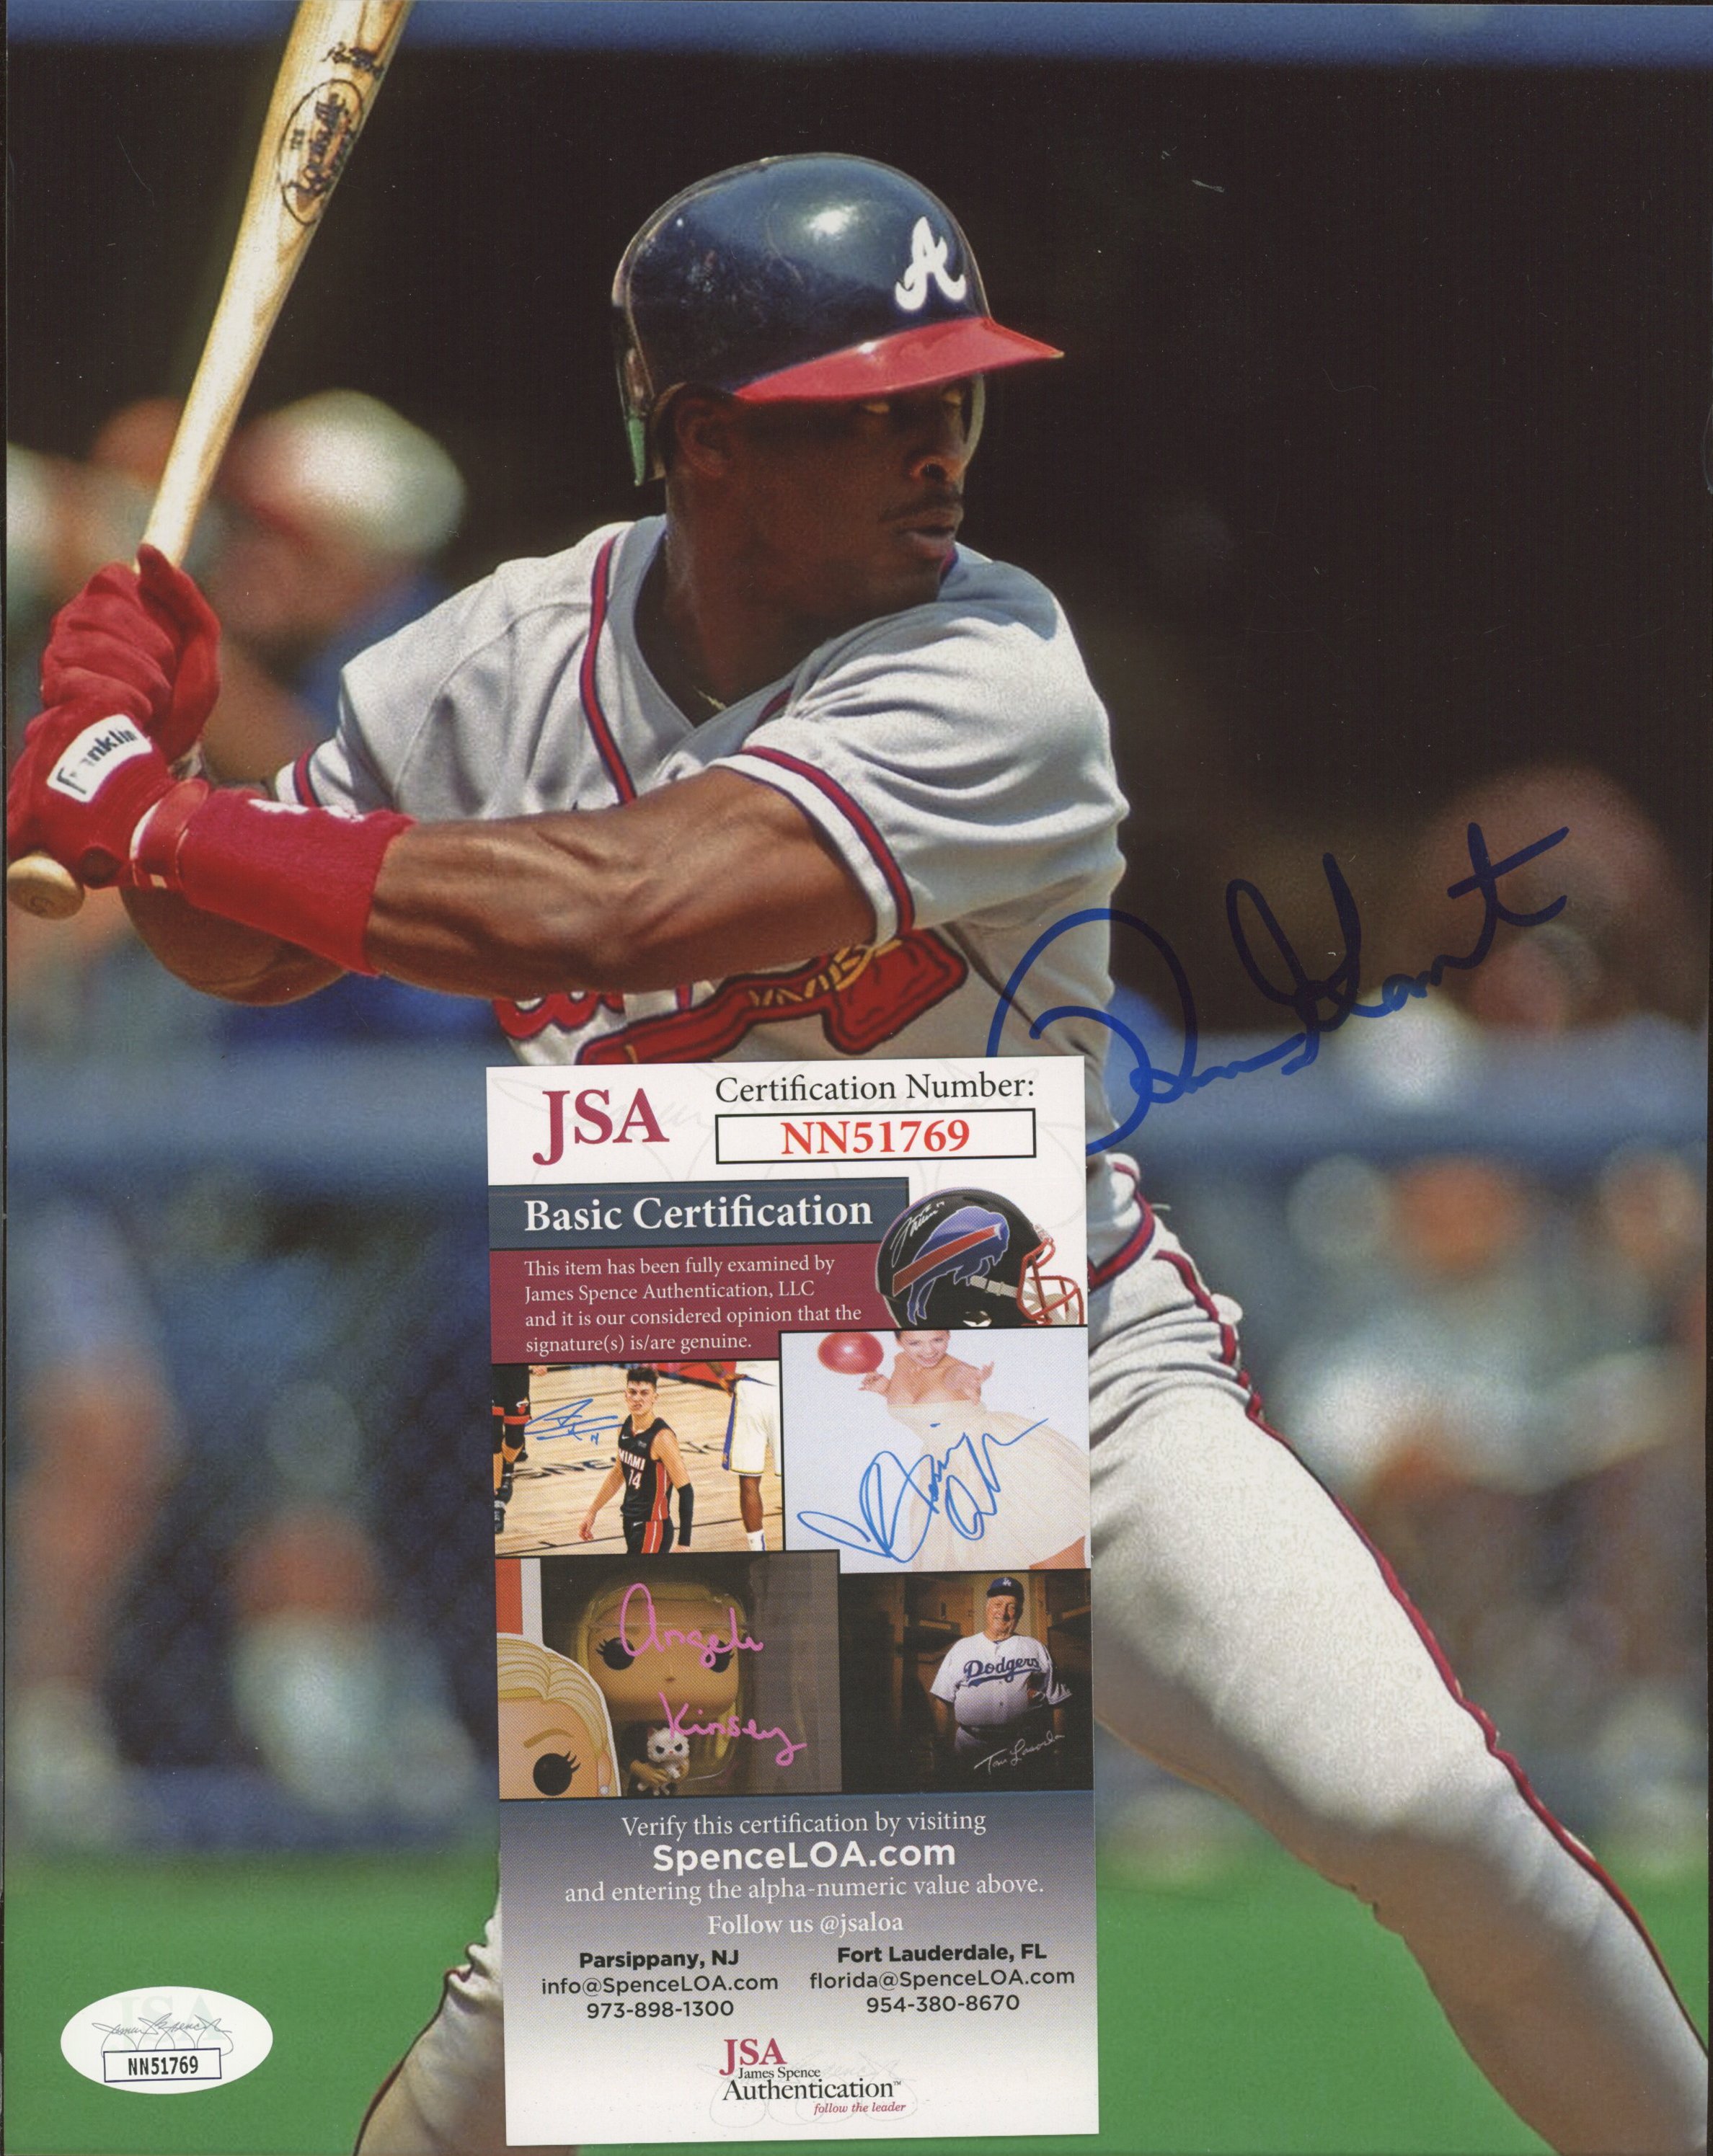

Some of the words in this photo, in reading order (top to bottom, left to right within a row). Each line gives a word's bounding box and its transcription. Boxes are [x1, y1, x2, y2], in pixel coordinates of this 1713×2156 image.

[895, 216, 966, 311] A
[56, 728, 138, 795] Fnklin
[715, 1074, 897, 1103] Certification
[905, 1070, 1034, 1099] Number:
[533, 1088, 669, 1166] JSA
[782, 1119, 970, 1155] NN51769
[524, 1199, 622, 1231] Basic
[632, 1194, 873, 1229] Certification
[524, 1260, 560, 1276] This
[566, 1259, 601, 1275] item
[607, 1259, 635, 1274] has
[640, 1258, 680, 1274] been
[686, 1256, 723, 1277] fully
[727, 1254, 810, 1272] examined
[814, 1254, 835, 1275] by
[525, 1286, 574, 1304] James
[579, 1285, 637, 1305] Spence
[642, 1282, 774, 1299] Authentication,
[778, 1280, 815, 1296] LLC
[526, 1310, 557, 1326] and
[562, 1310, 573, 1326] it
[577, 1310, 591, 1326] is
[596, 1314, 626, 1326] our
[630, 1307, 722, 1325] considered
[727, 1308, 792, 1328] opinion
[797, 1305, 831, 1321] that
[835, 1304, 862, 1321] the
[526, 1334, 624, 1357] signature(s)
[630, 1334, 676, 1351] is/are
[681, 1334, 751, 1354] genuine.
[619, 1448, 646, 1470] MIAMI
[628, 1469, 642, 1490] 14
[963, 1656, 1041, 1683] Dodgers
[621, 1814, 688, 1842] Verify
[693, 1814, 733, 1835] this
[739, 1812, 869, 1835] certification
[875, 1811, 901, 1837] by
[906, 1811, 986, 1836] visiting
[653, 1840, 955, 1876] SpenceLOA.com
[565, 1881, 605, 1902] and
[611, 1881, 702, 1906] entering
[707, 1880, 742, 1899] the
[748, 1876, 907, 1904] alpha-numeric
[913, 1874, 970, 1895] value
[976, 1873, 1044, 1894] above.
[708, 1914, 783, 1935] Follow
[789, 1919, 814, 1933] us
[820, 1911, 904, 1938] @jsaloa
[580, 1951, 705, 1971] Parsippany,
[712, 1949, 739, 1966] NJ
[838, 1947, 882, 1964] Fort
[889, 1943, 1014, 1963] Lauderdale,
[1021, 1943, 1048, 1960] FL
[541, 1975, 778, 1997] info@SpenceLOA.com
[810, 1969, 1075, 1990] florida@SpenceLOA.com
[586, 2000, 734, 2019] 973-898-1300
[866, 1994, 1020, 2013] 954-380-8670
[128, 2055, 198, 2076] NN51769
[719, 2039, 786, 2076] JSA
[738, 2067, 775, 2079] James
[777, 2067, 822, 2082] Spence
[814, 2103, 847, 2113] follow
[851, 2103, 868, 2111] the
[872, 2103, 906, 2112] leader
